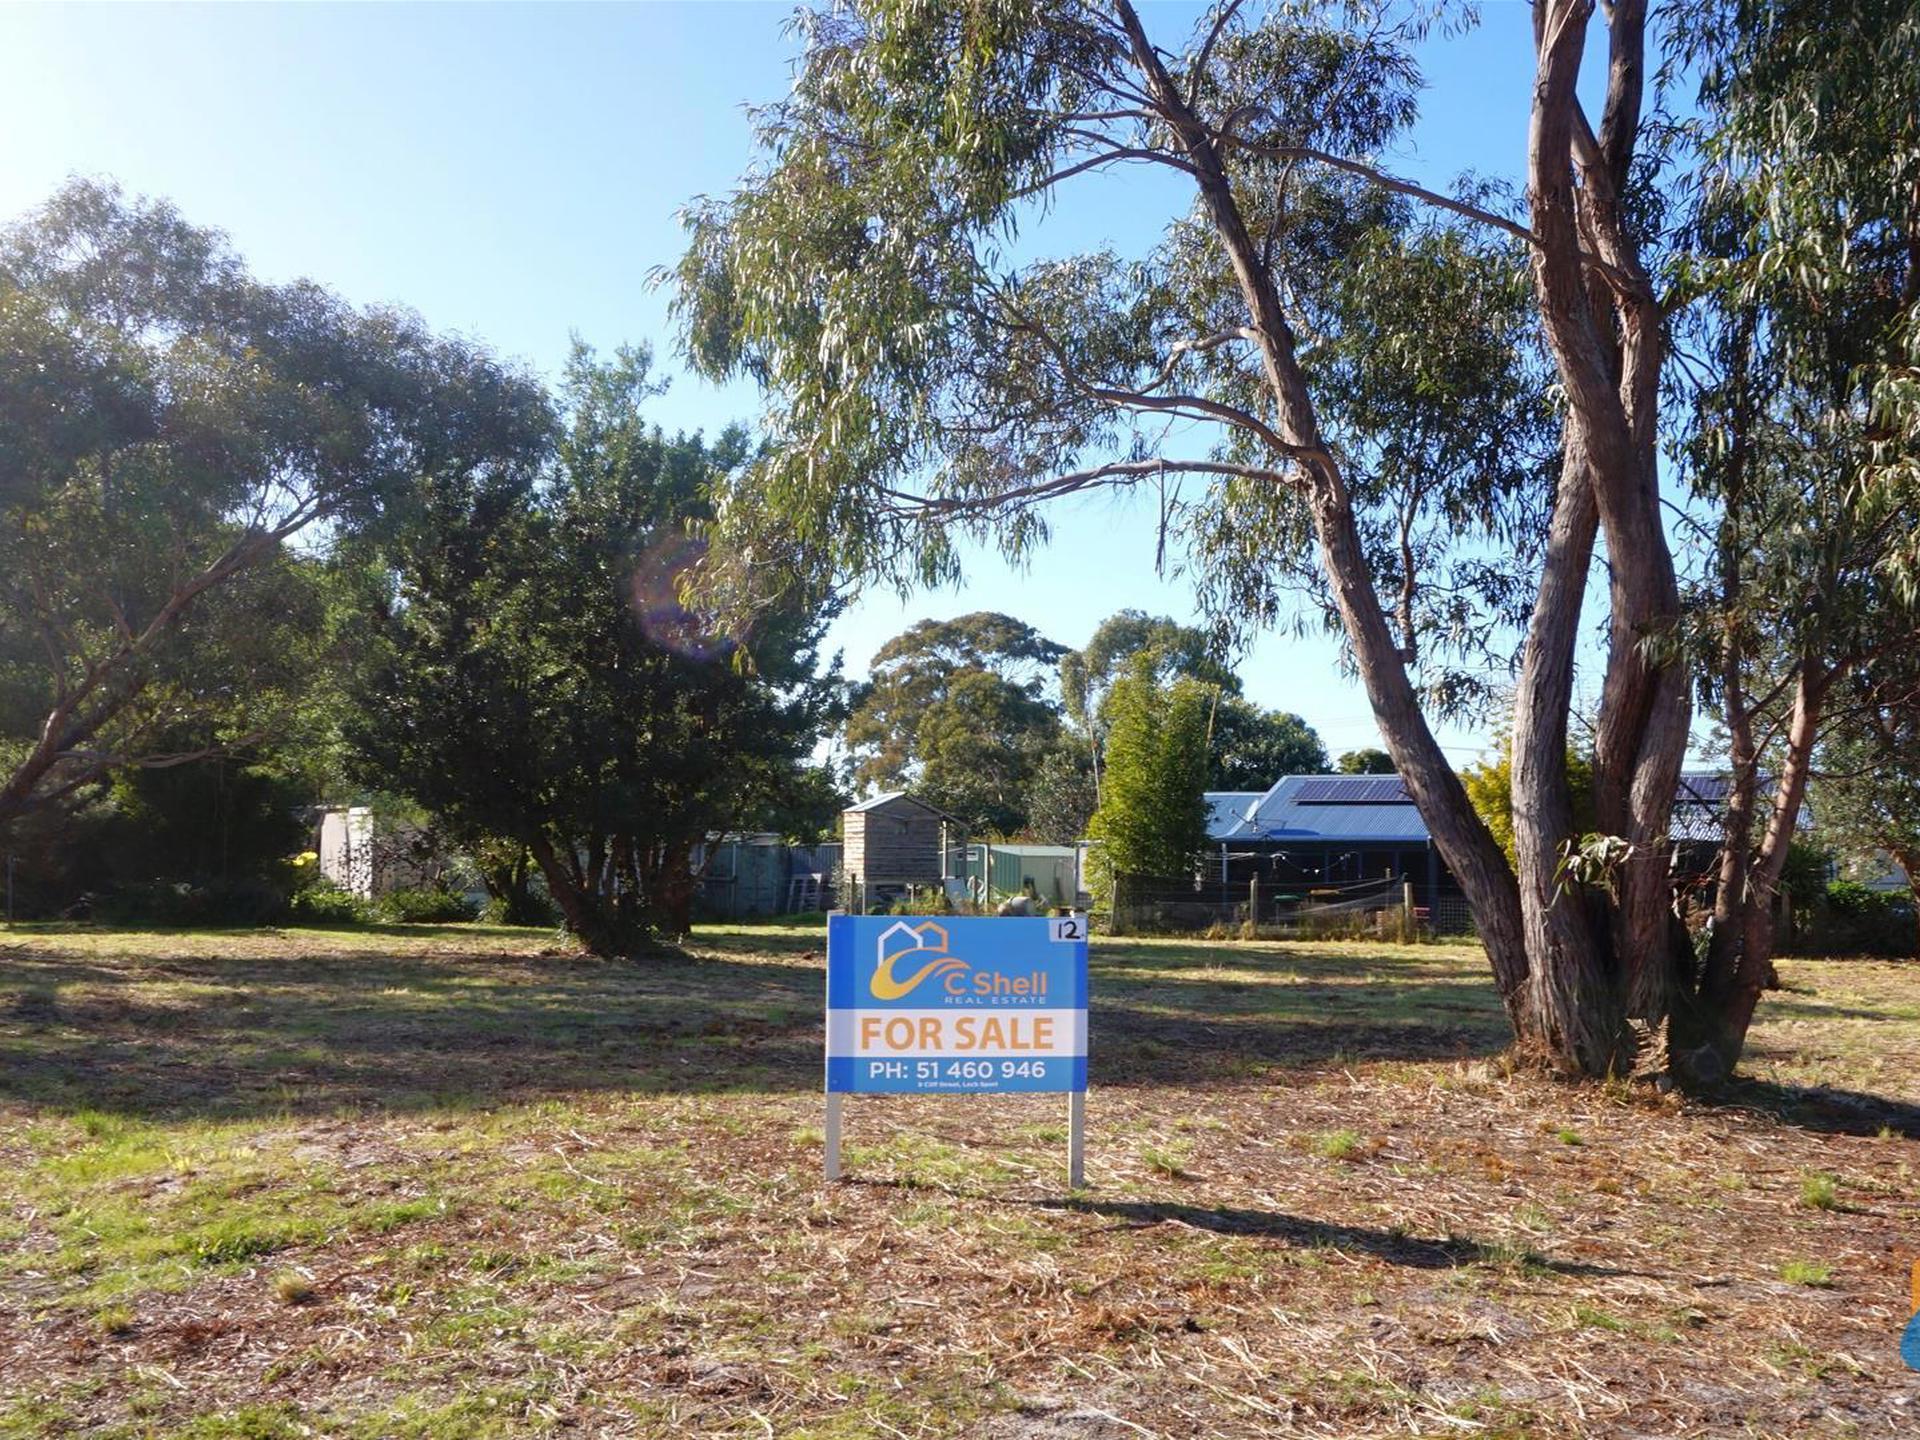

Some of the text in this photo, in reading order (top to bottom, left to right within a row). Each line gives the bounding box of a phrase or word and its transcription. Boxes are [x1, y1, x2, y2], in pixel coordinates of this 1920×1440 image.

[944, 972, 1047, 996] C Shell
[944, 996, 1047, 1005] REAL ESTATE
[861, 1017, 1054, 1050] FOR SALE
[869, 1062, 1046, 1079] PH: 51 460 946
